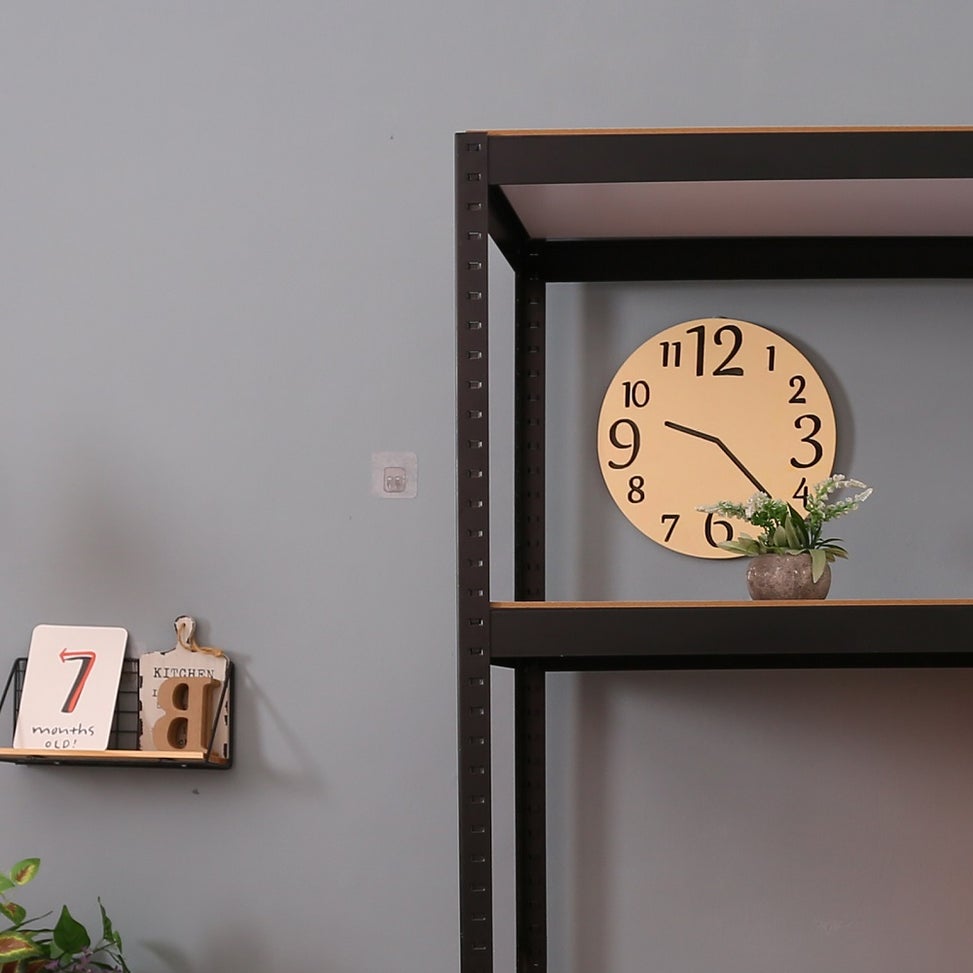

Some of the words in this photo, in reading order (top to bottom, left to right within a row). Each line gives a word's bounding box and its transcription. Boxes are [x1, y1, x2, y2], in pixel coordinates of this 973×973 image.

[659, 341, 682, 368] 11
[686, 324, 745, 377] 12
[766, 345, 776, 372] 1
[622, 380, 650, 408] 10
[788, 375, 807, 404] 2
[608, 418, 641, 470] 9
[790, 414, 824, 469] 3
[627, 475, 646, 504] 8
[792, 477, 809, 509] 4
[660, 514, 681, 543] 7
[704, 512, 734, 549] 6
[59, 648, 96, 714] 7
[32, 723, 95, 736] months
[45, 740, 77, 749] OLD!
